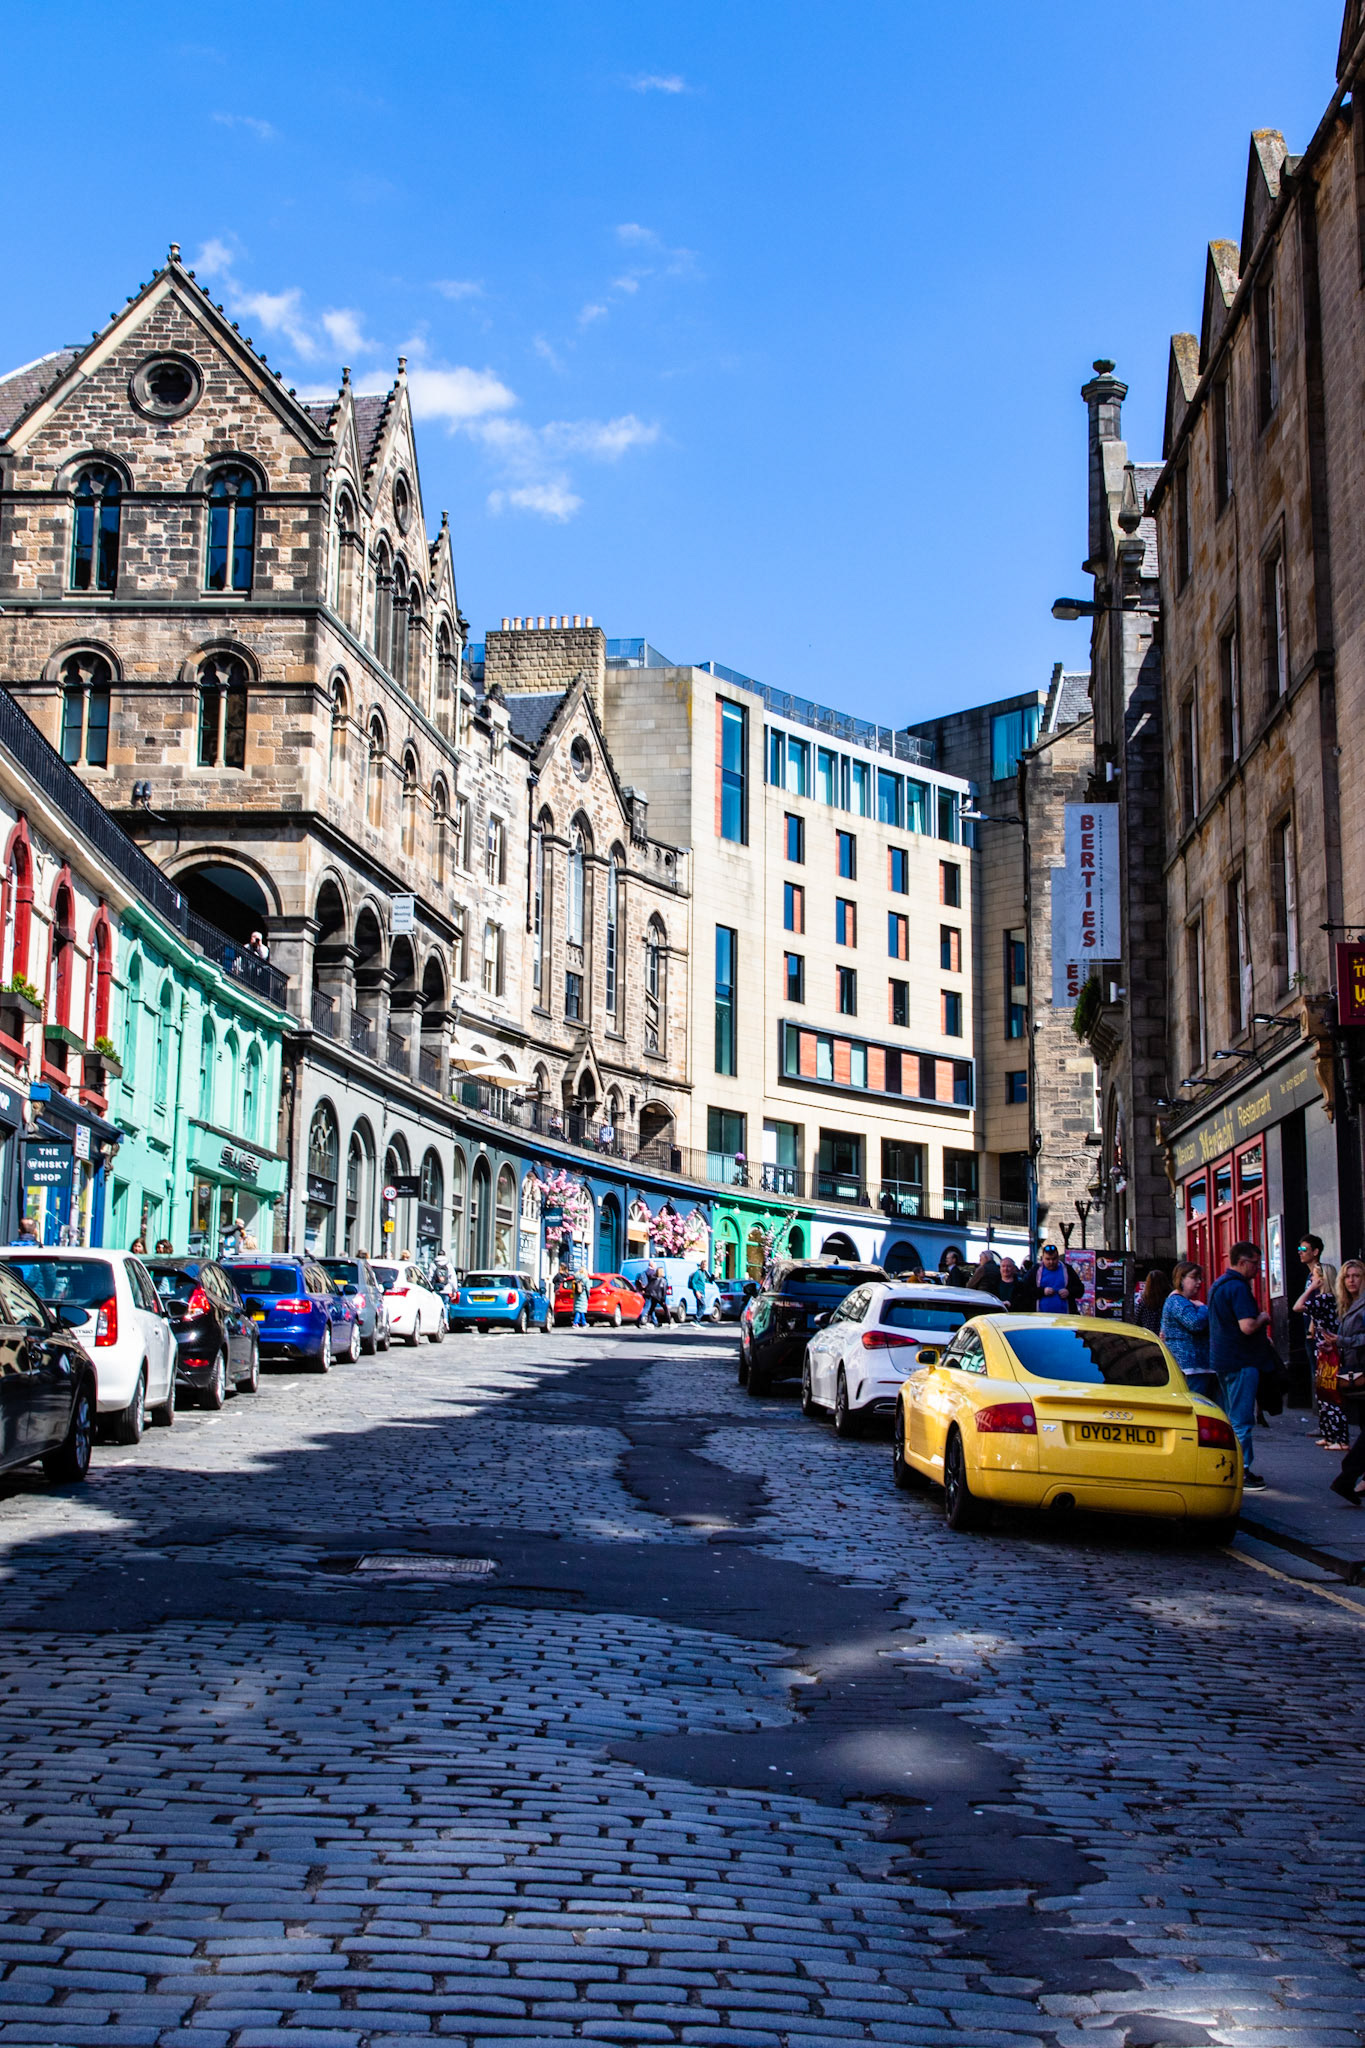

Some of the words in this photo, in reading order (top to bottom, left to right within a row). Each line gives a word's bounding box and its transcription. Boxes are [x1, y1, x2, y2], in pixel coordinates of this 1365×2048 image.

[1081, 814, 1096, 947] BERTIES
[1176, 1142, 1196, 1167] Mexican
[1199, 1105, 1235, 1164] Mariachi
[1237, 1088, 1272, 1128] Restaurant
[39, 1147, 59, 1156] THE
[28, 1160, 69, 1169] WHISKY
[33, 1173, 61, 1182] SHOP
[385, 1189, 395, 1197] 20
[1042, 1423, 1057, 1432] TT
[1081, 1425, 1121, 1441] OY02
[1126, 1428, 1156, 1444] HLO
